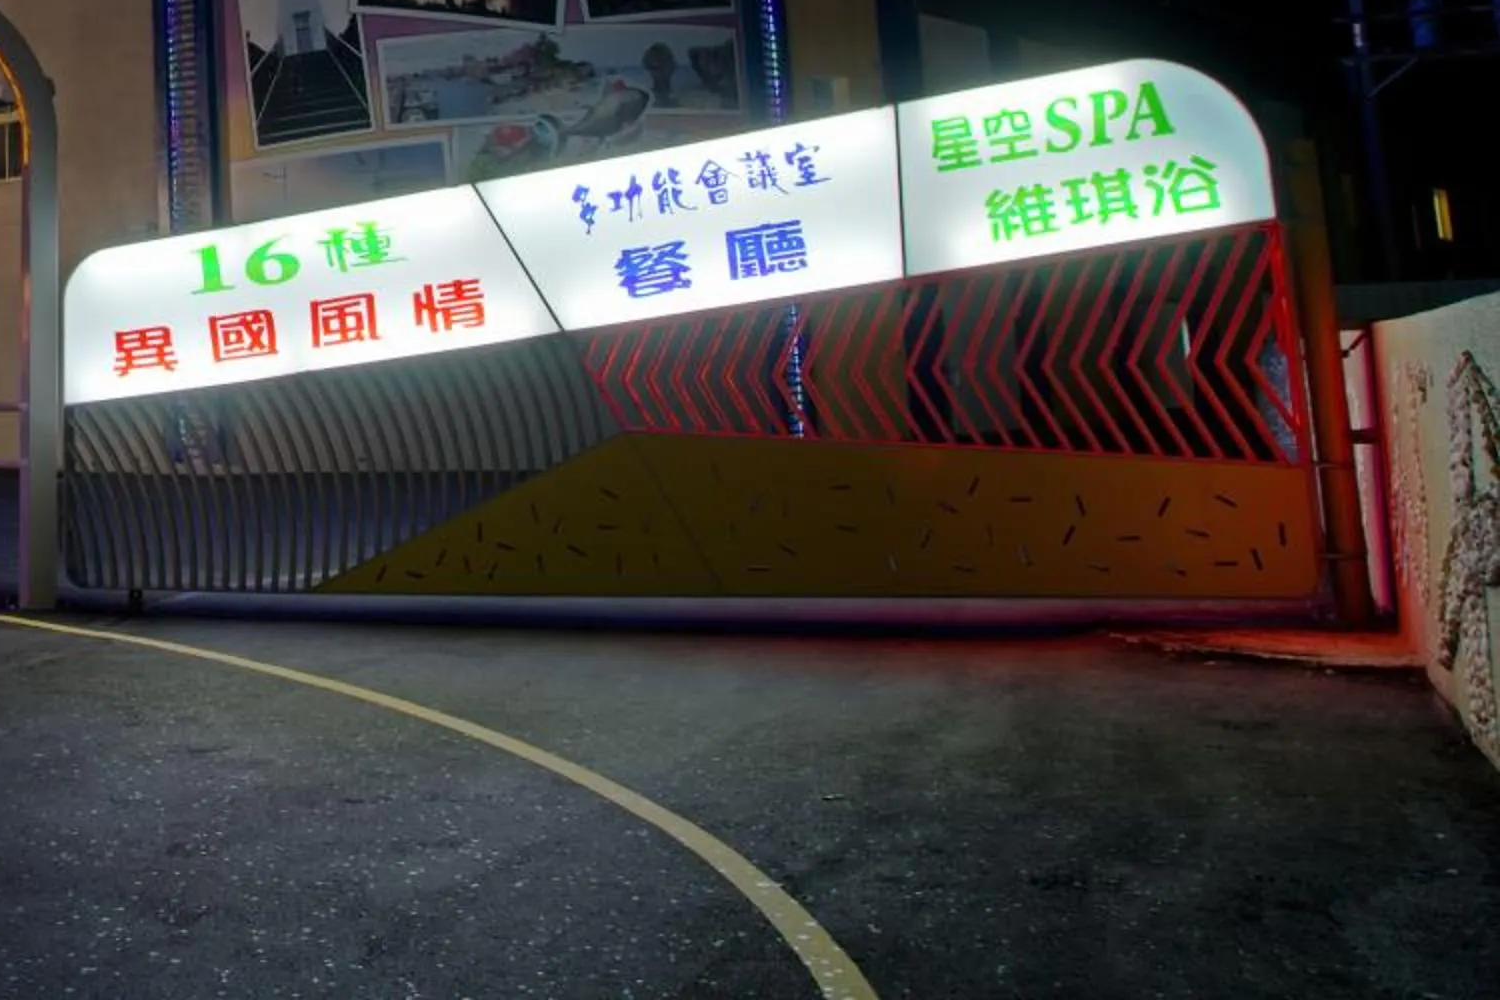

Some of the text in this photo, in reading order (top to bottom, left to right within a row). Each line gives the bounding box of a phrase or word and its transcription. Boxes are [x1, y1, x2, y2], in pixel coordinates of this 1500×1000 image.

[930, 80, 1177, 173] 星空SPA
[984, 153, 1221, 244] 維琪浴
[190, 220, 408, 295] 16種
[613, 219, 809, 298] 餐廳
[112, 278, 487, 378] 異國風情
